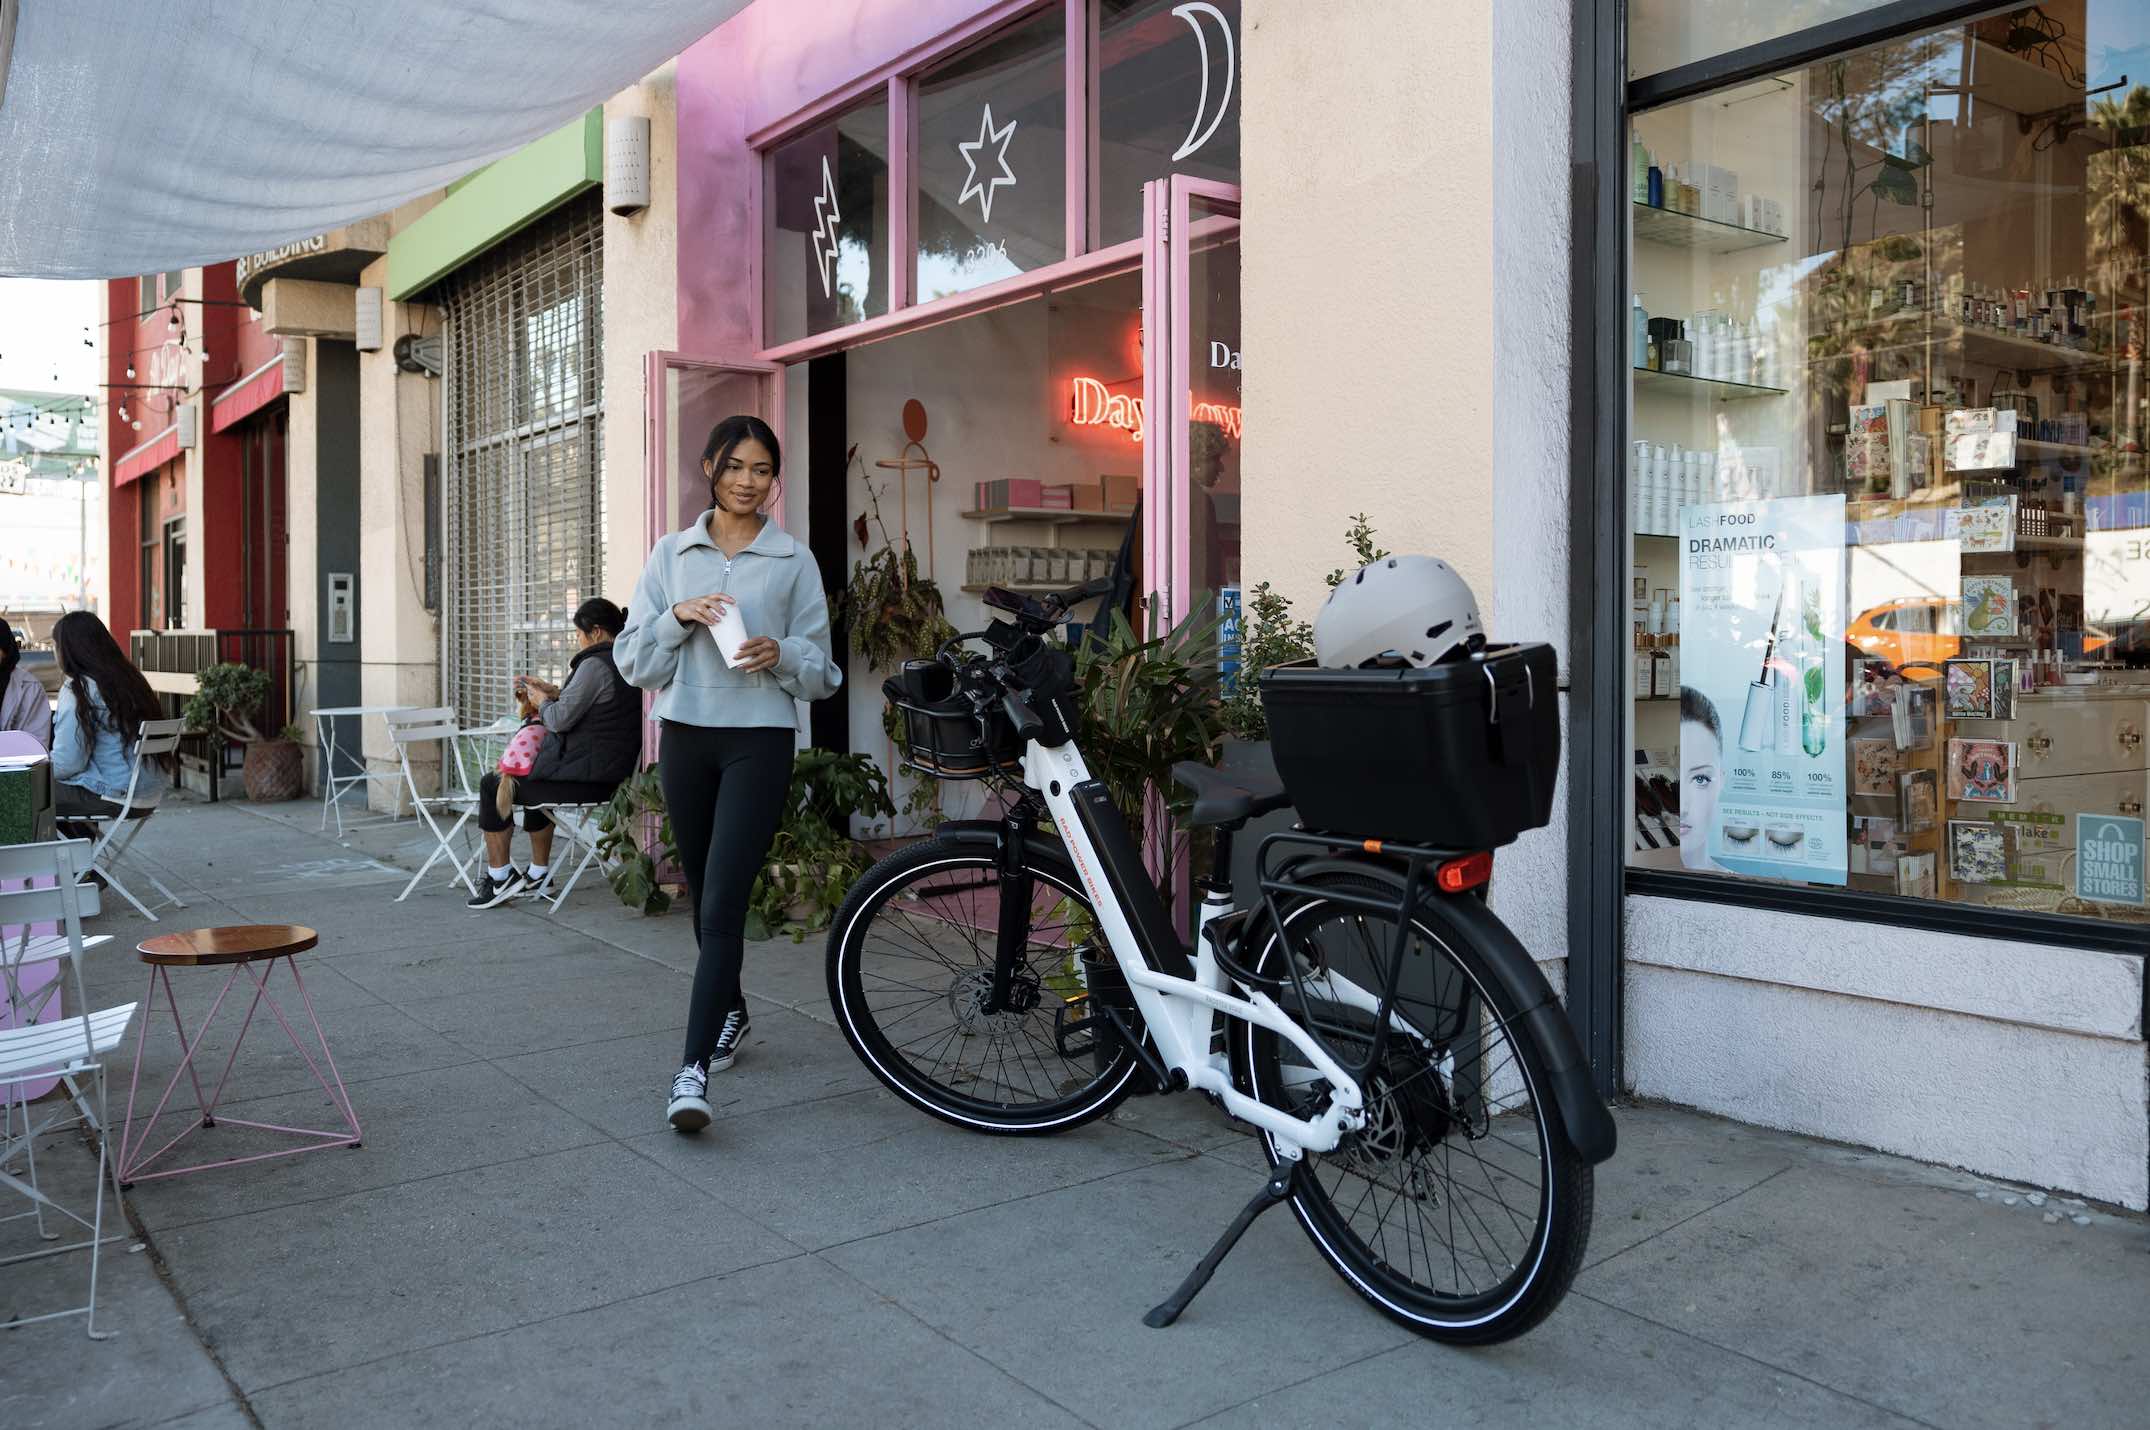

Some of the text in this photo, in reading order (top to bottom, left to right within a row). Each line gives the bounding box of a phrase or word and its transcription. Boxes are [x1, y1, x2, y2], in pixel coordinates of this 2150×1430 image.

[1690, 534, 1776, 553] DRAMATIC
[1733, 768, 1832, 782] 100% 85% 100%
[2083, 839, 2139, 864] SHOP
[2083, 860, 2138, 882] SMALL
[2083, 877, 2138, 898] STORES
